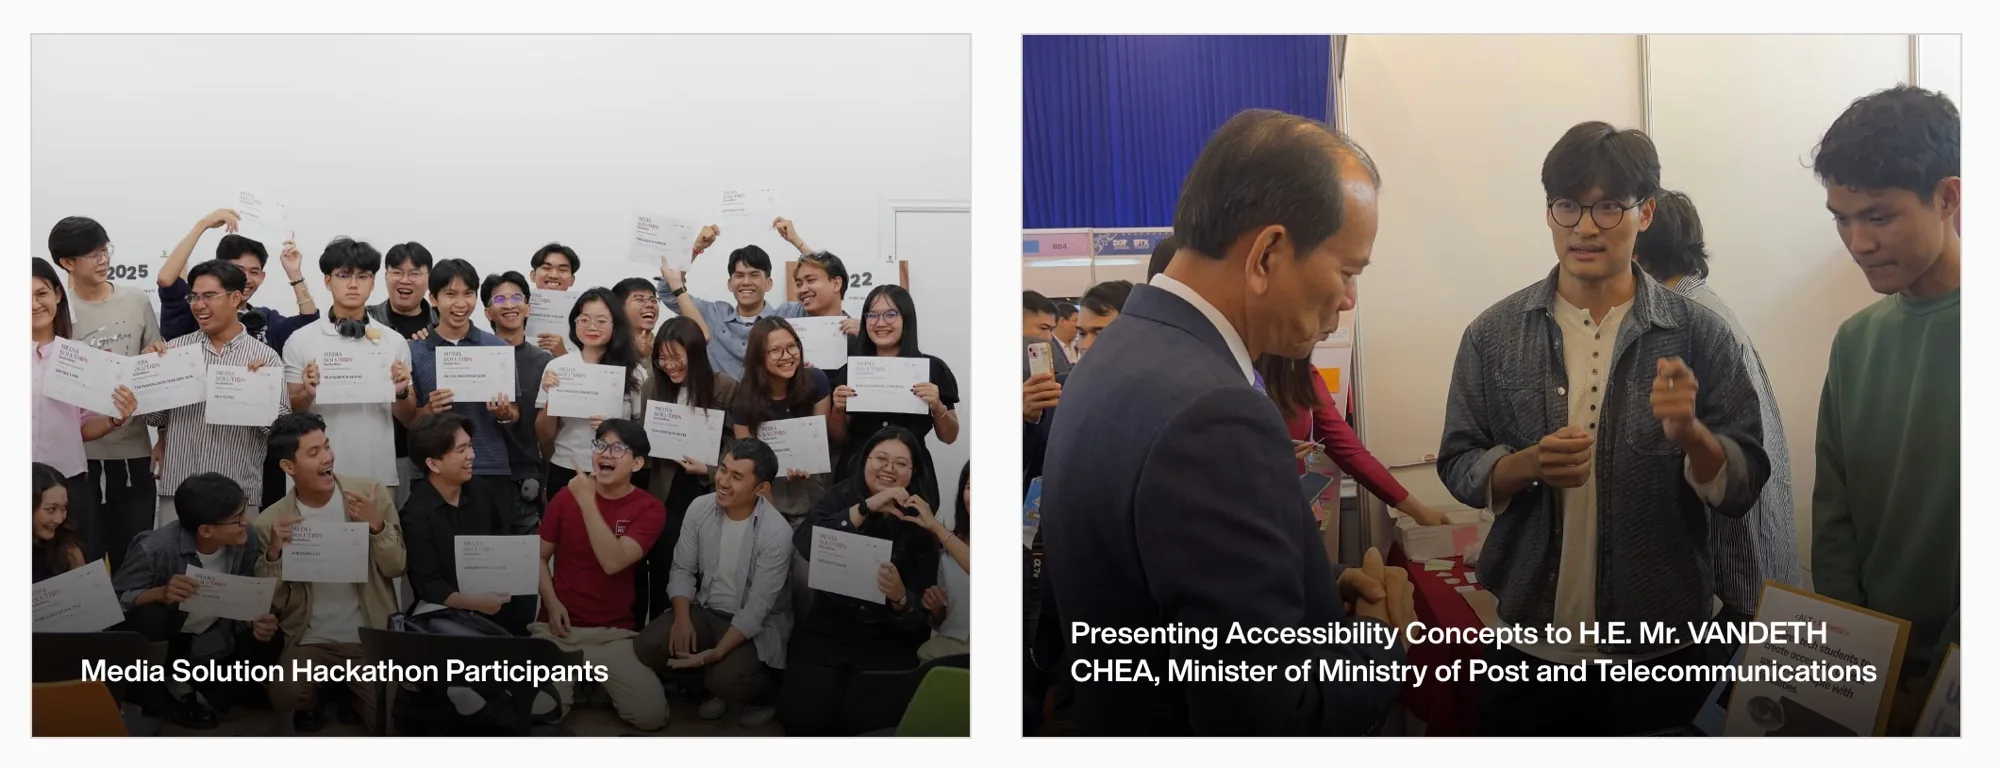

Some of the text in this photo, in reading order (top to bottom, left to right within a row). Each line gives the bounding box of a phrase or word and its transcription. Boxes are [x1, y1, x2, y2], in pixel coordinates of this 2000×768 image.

[107, 264, 149, 280] 2025
[1764, 641, 1790, 657] create
[1819, 645, 1859, 665] students
[1832, 682, 1854, 699] with
